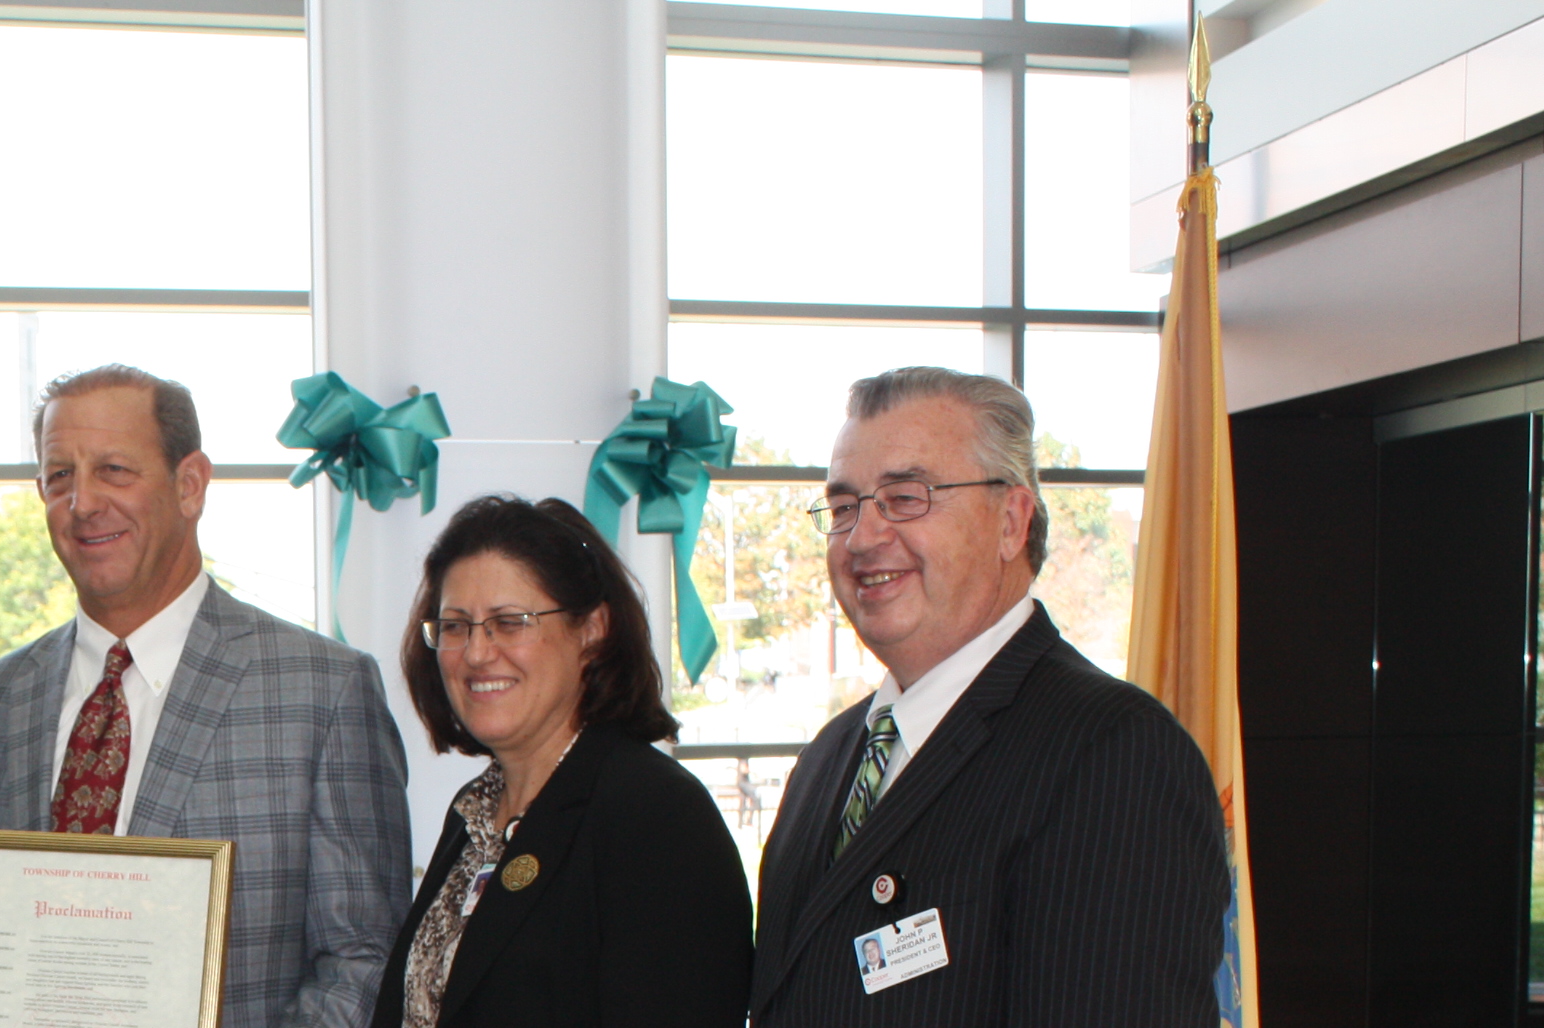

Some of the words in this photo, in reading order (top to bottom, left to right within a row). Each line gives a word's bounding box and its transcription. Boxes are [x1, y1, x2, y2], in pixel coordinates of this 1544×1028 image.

[23, 867, 71, 878] TOWNSHIP
[72, 870, 85, 878] OF
[87, 870, 126, 880] CHERRY
[128, 872, 151, 882] HILL
[34, 900, 133, 920] Proclamation
[886, 937, 926, 957] SHERIDAN
[927, 932, 937, 941] JR
[895, 931, 916, 944] JOHN
[890, 950, 922, 966] PRESIDENT
[928, 943, 941, 952] CEO
[900, 958, 947, 979] ADMINISTRATION
